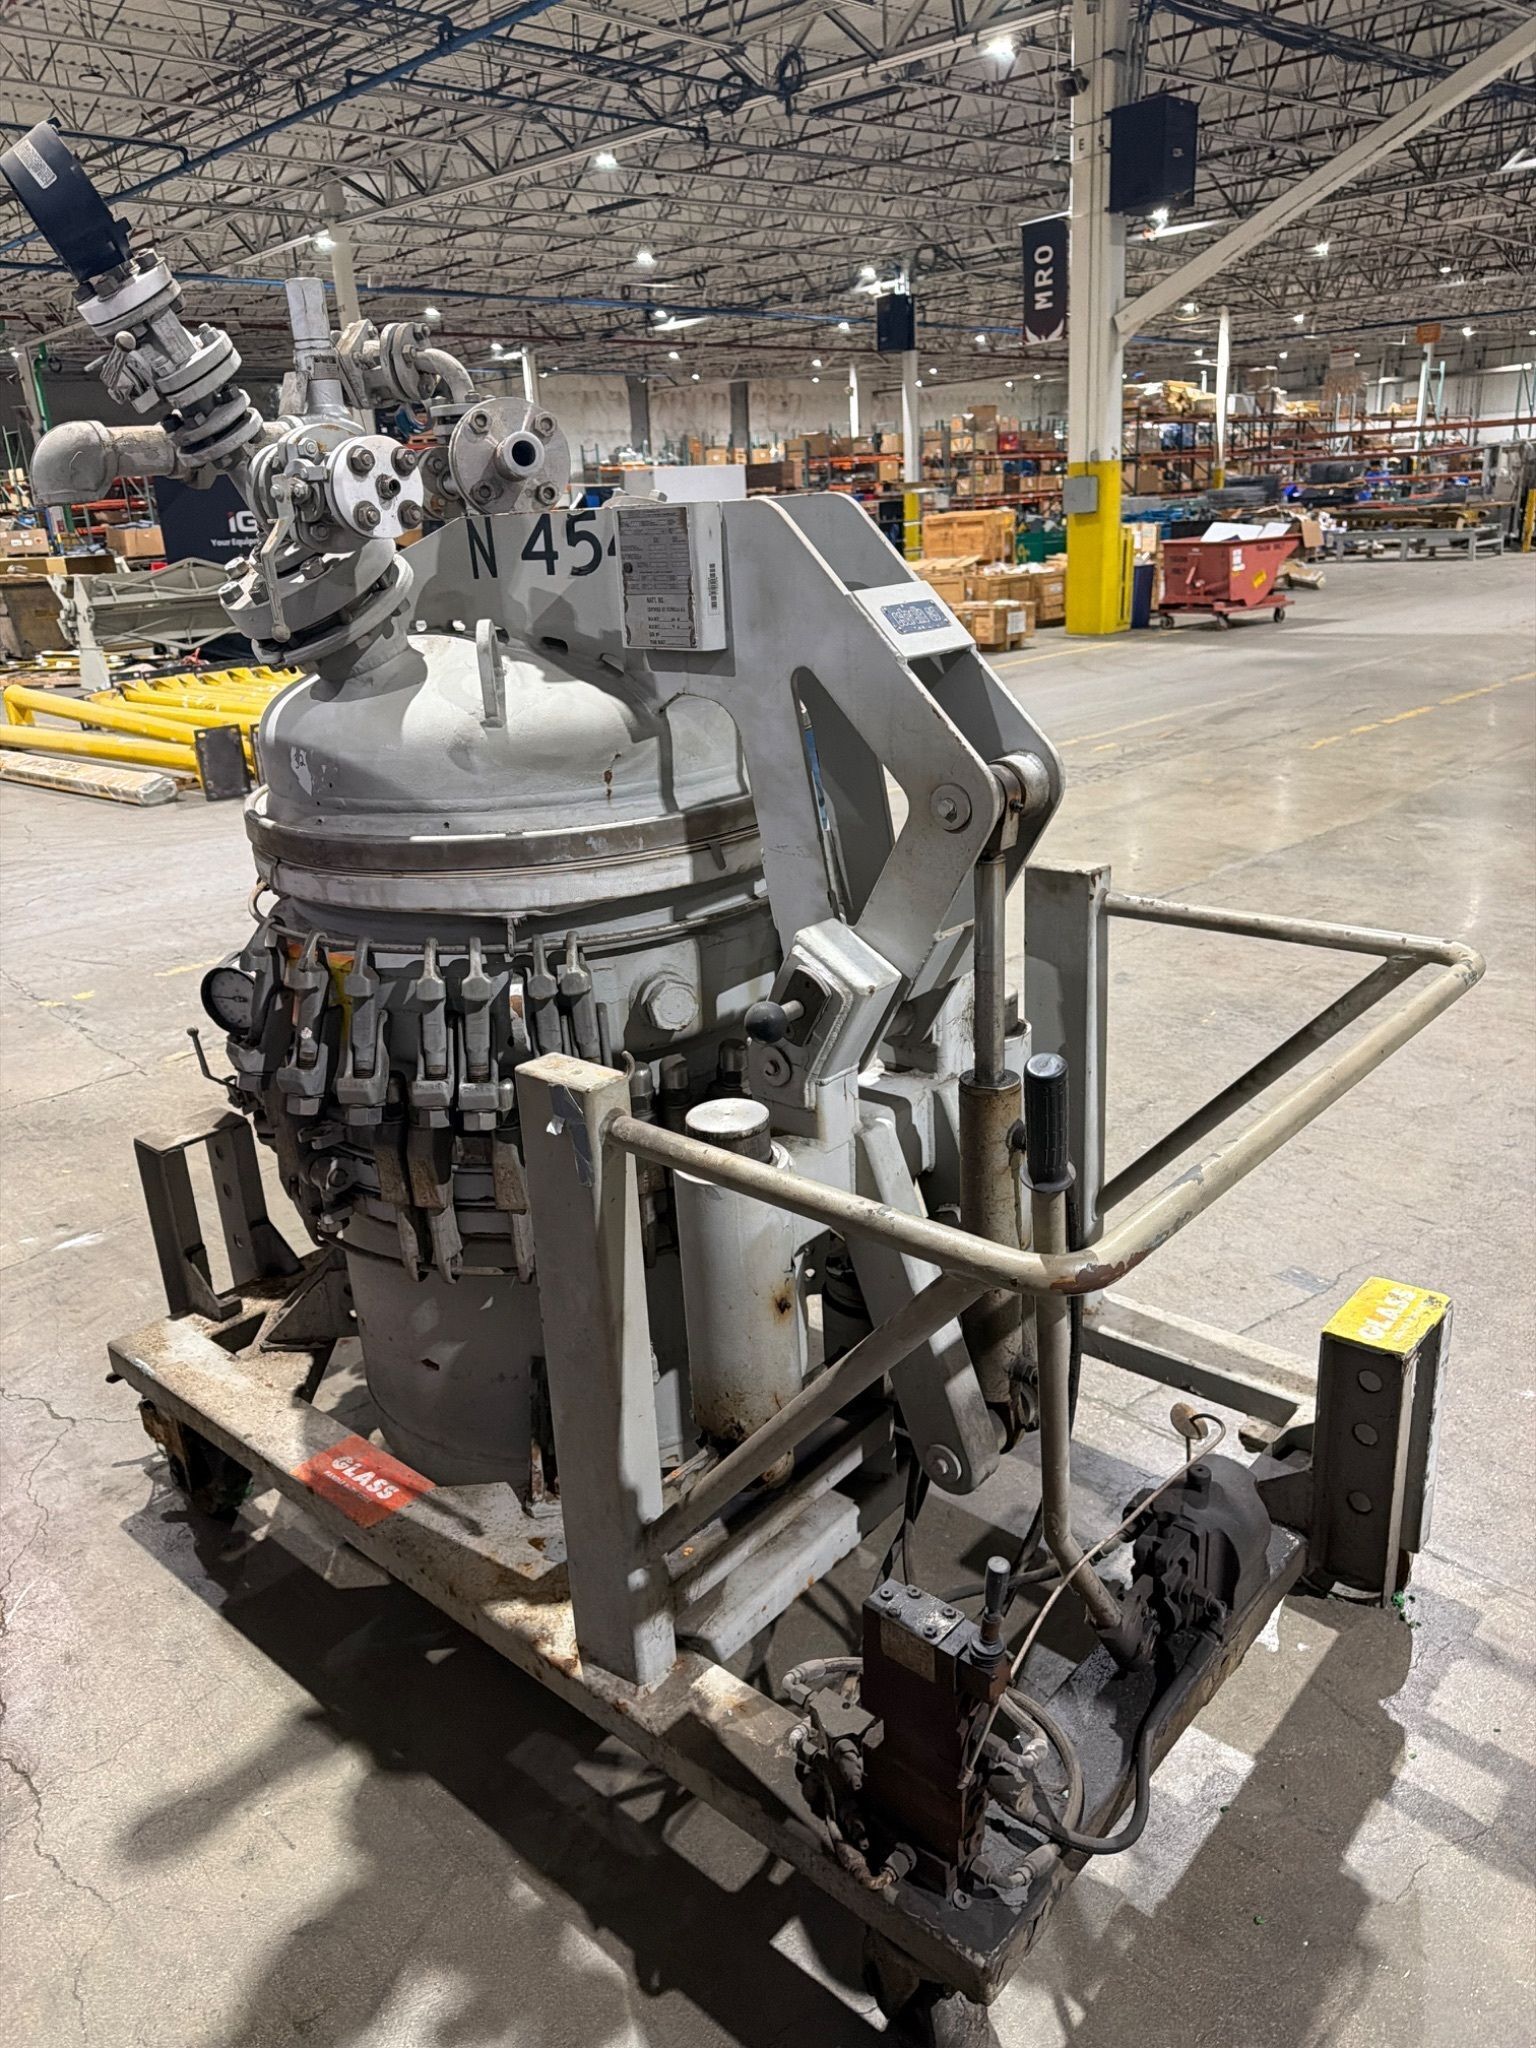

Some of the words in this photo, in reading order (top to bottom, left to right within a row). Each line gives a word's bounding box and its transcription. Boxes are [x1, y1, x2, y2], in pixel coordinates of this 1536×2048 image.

[1034, 245, 1054, 311] MRO
[210, 538, 231, 547] Your
[466, 516, 498, 579] N
[521, 511, 617, 576] 45
[331, 1456, 400, 1499] GLASS
